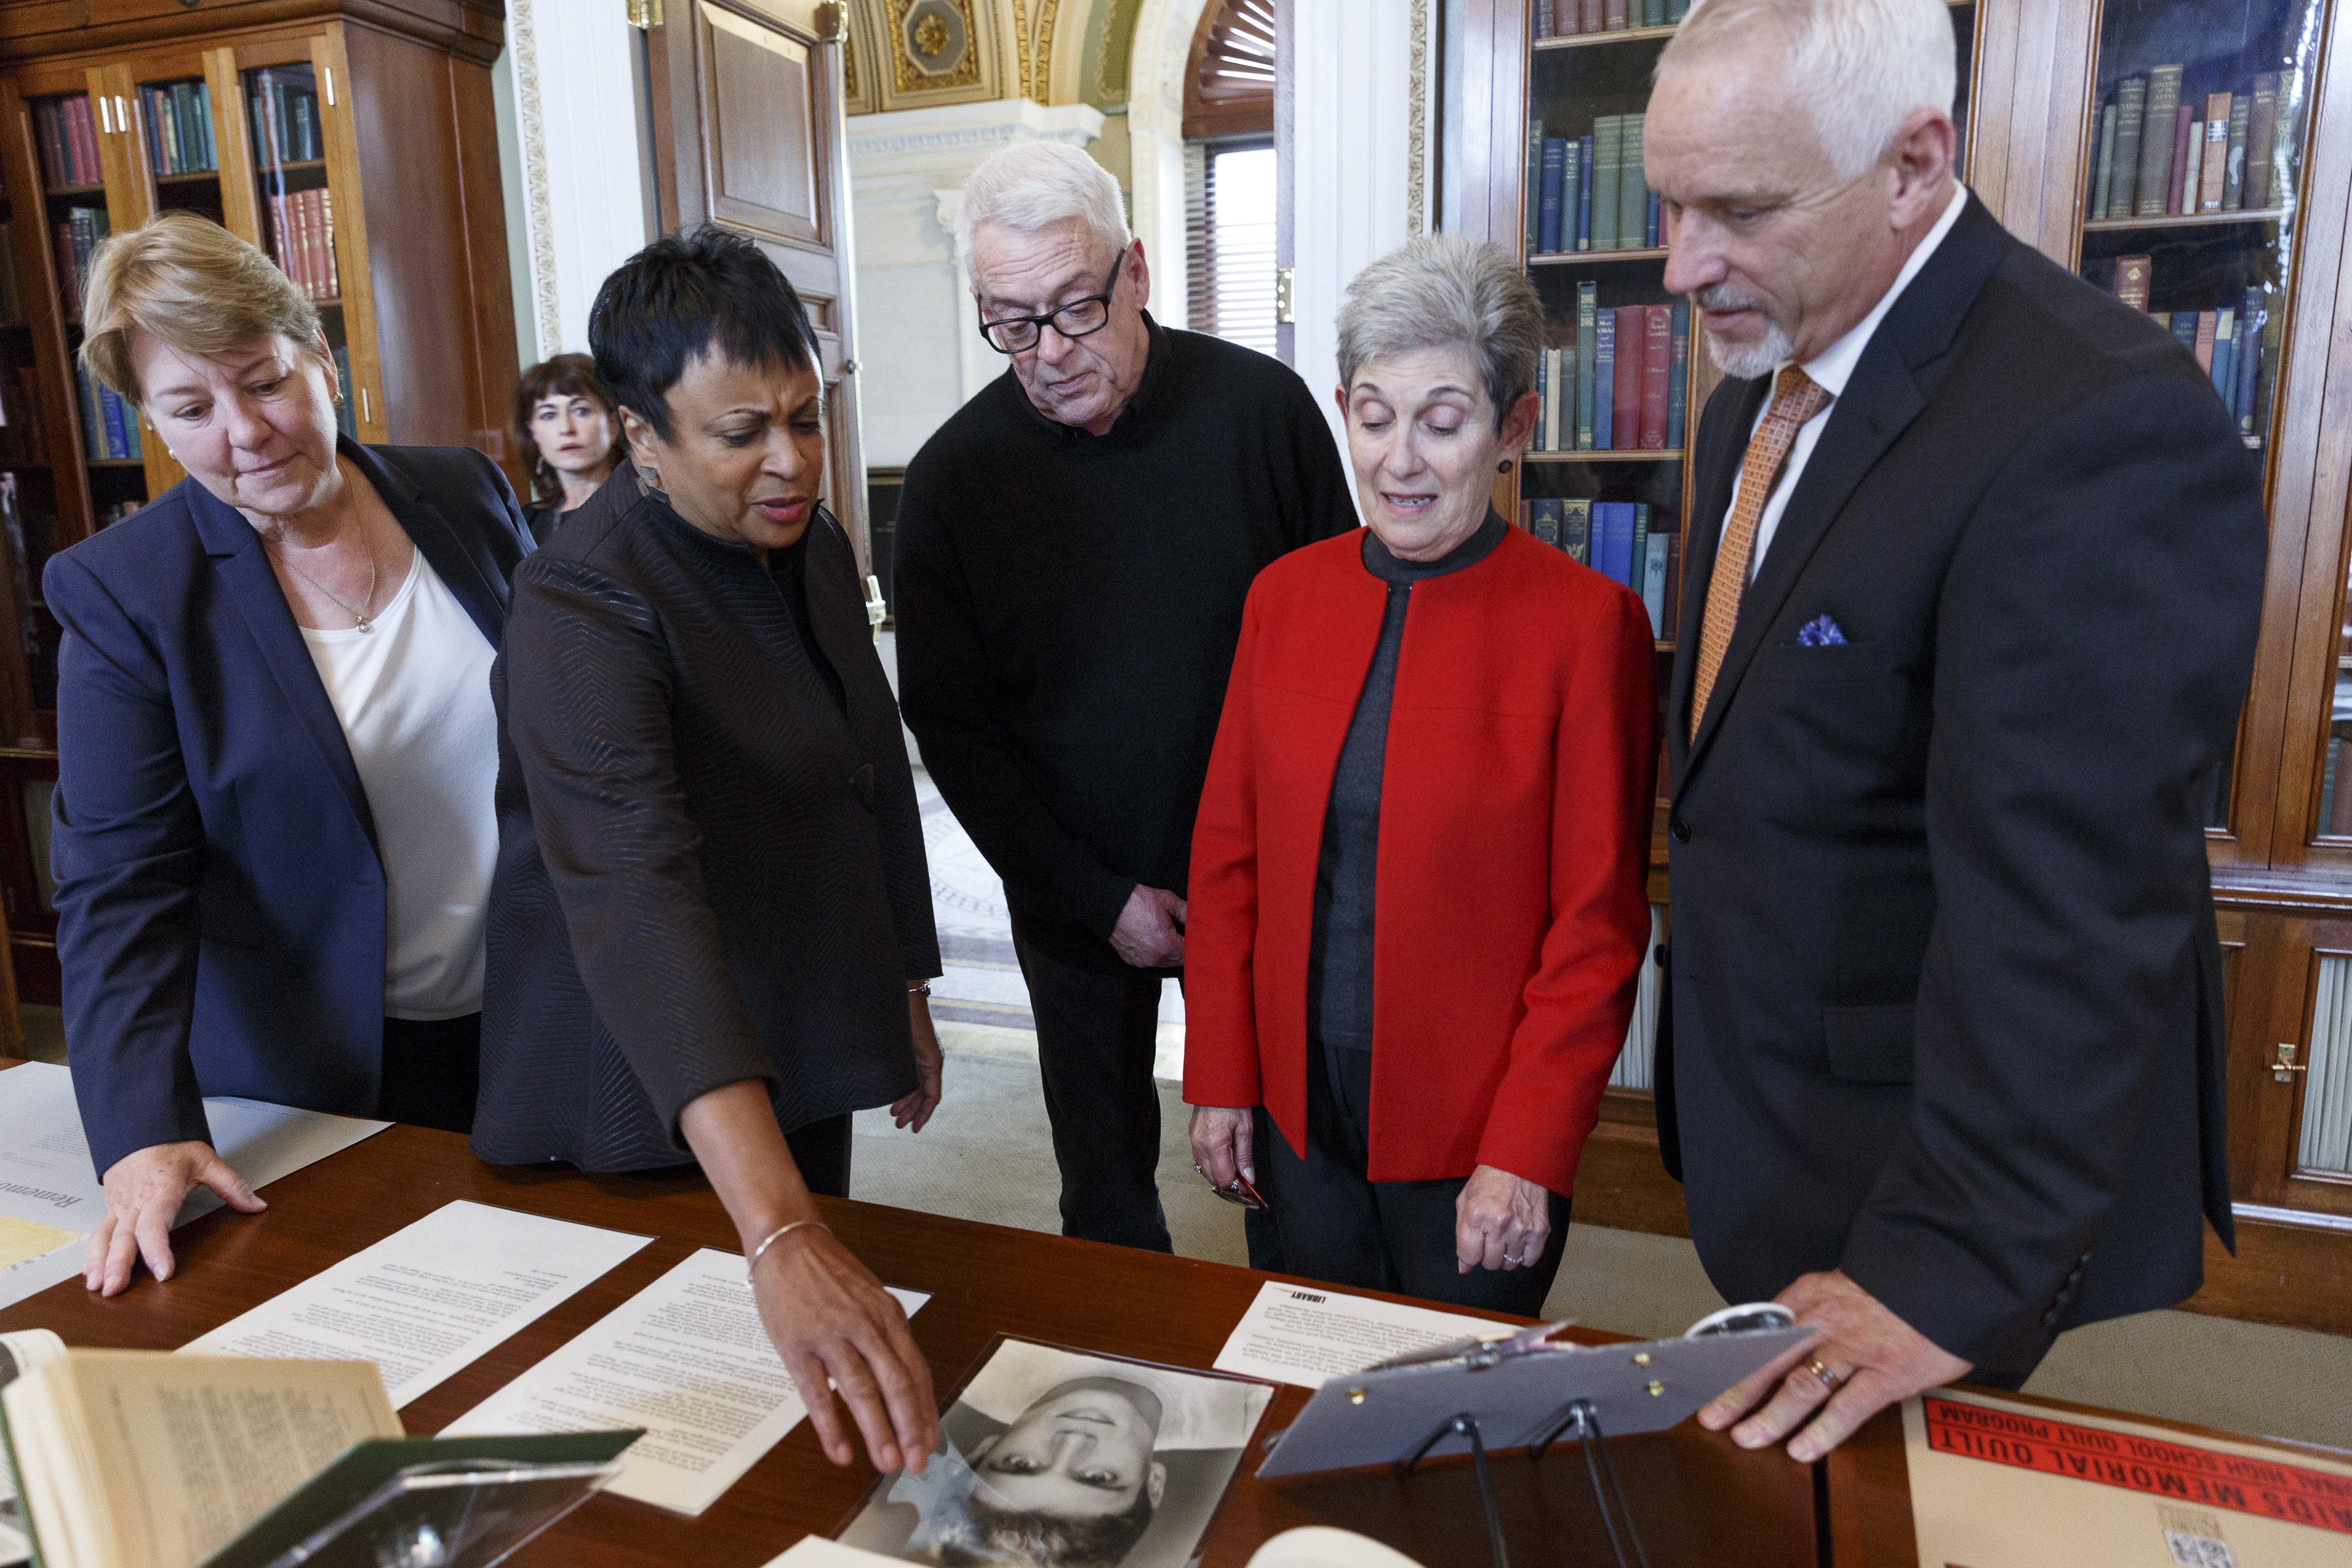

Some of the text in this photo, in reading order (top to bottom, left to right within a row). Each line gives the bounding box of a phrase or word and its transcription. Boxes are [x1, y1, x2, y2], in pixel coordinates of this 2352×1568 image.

[1291, 1290, 1326, 1303] LIBRARY
[1939, 1405, 2049, 1439] PROGRAM
[1940, 1428, 2033, 1463] QUILT
[2058, 1427, 2118, 1452] QUILT
[2131, 1441, 2217, 1472] SCHOOL
[2048, 1450, 2246, 1506] MEMORIAL
[2226, 1461, 2287, 1484] HIGH
